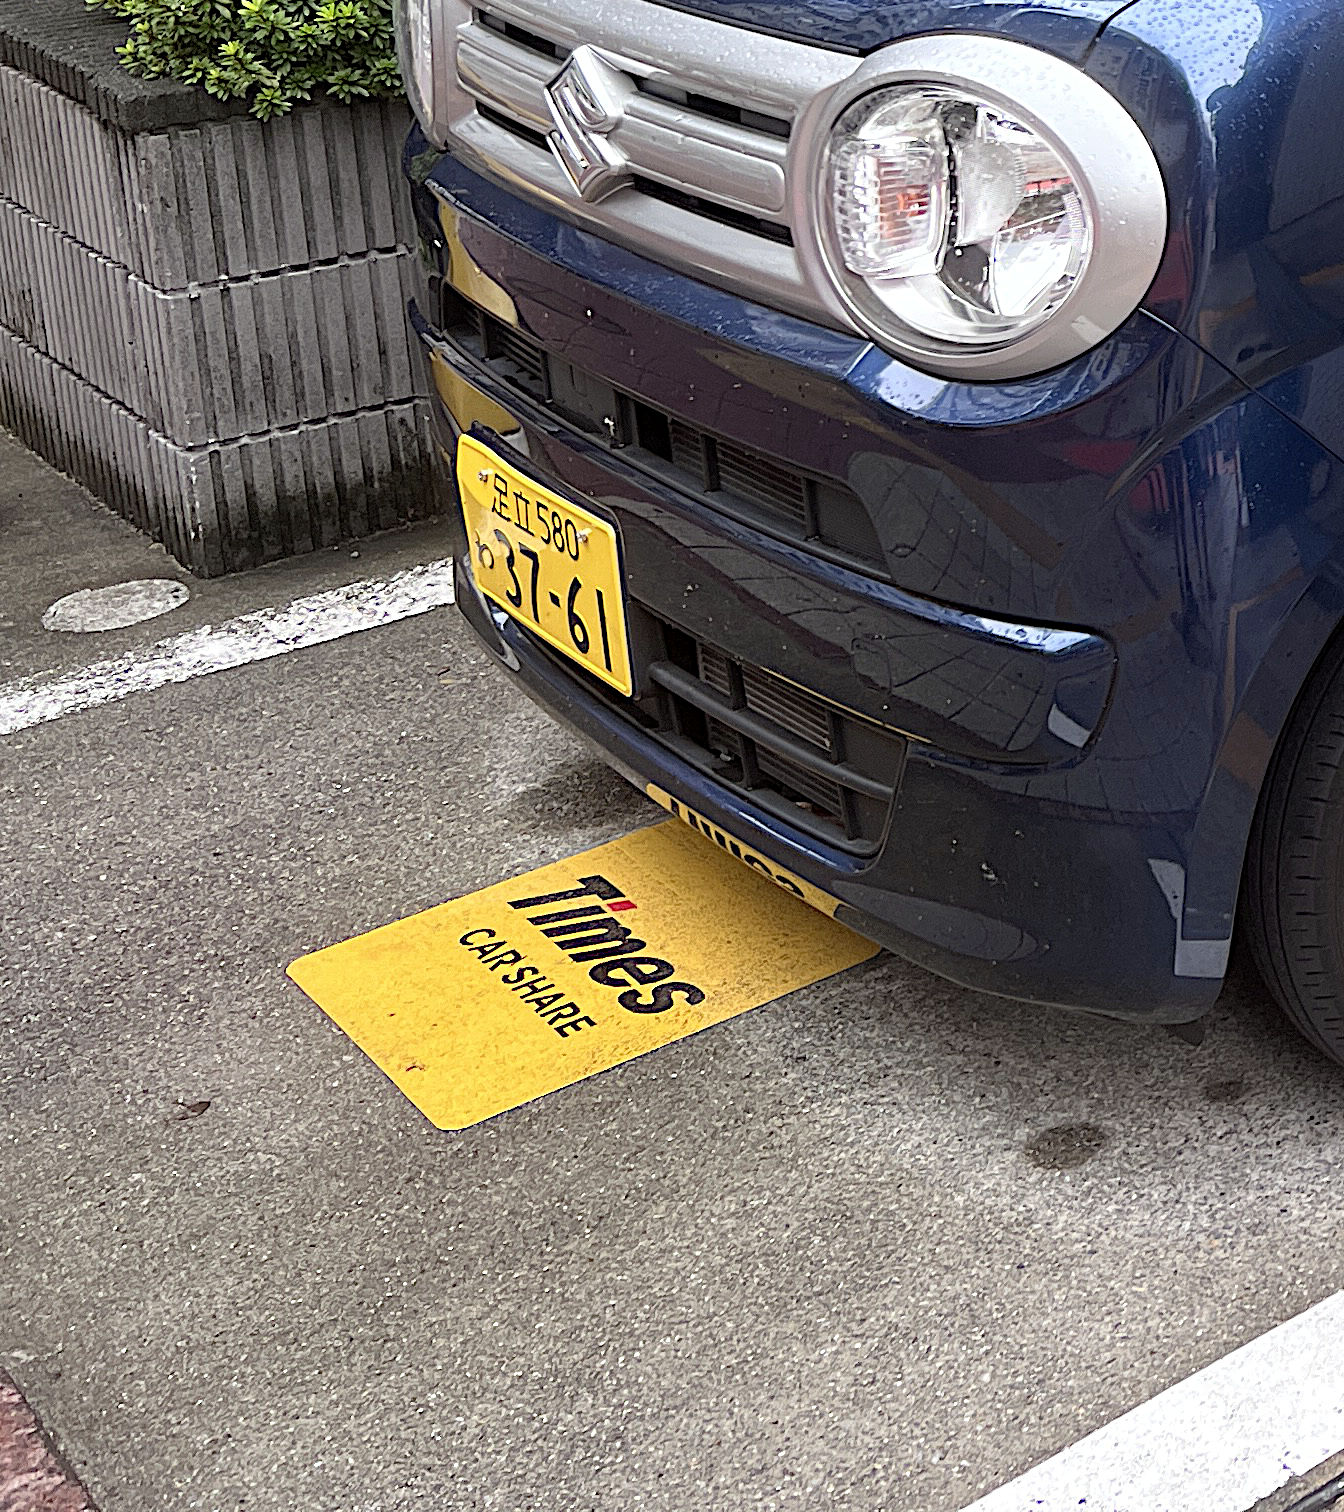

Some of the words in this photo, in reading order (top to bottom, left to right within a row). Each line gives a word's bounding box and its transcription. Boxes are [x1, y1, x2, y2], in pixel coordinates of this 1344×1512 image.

[491, 473, 535, 536] 足立
[536, 500, 579, 561] 580
[494, 529, 613, 673] 37-61
[459, 928, 525, 972] CAR
[501, 966, 598, 1038] SHARE
[506, 874, 706, 1015] Times
